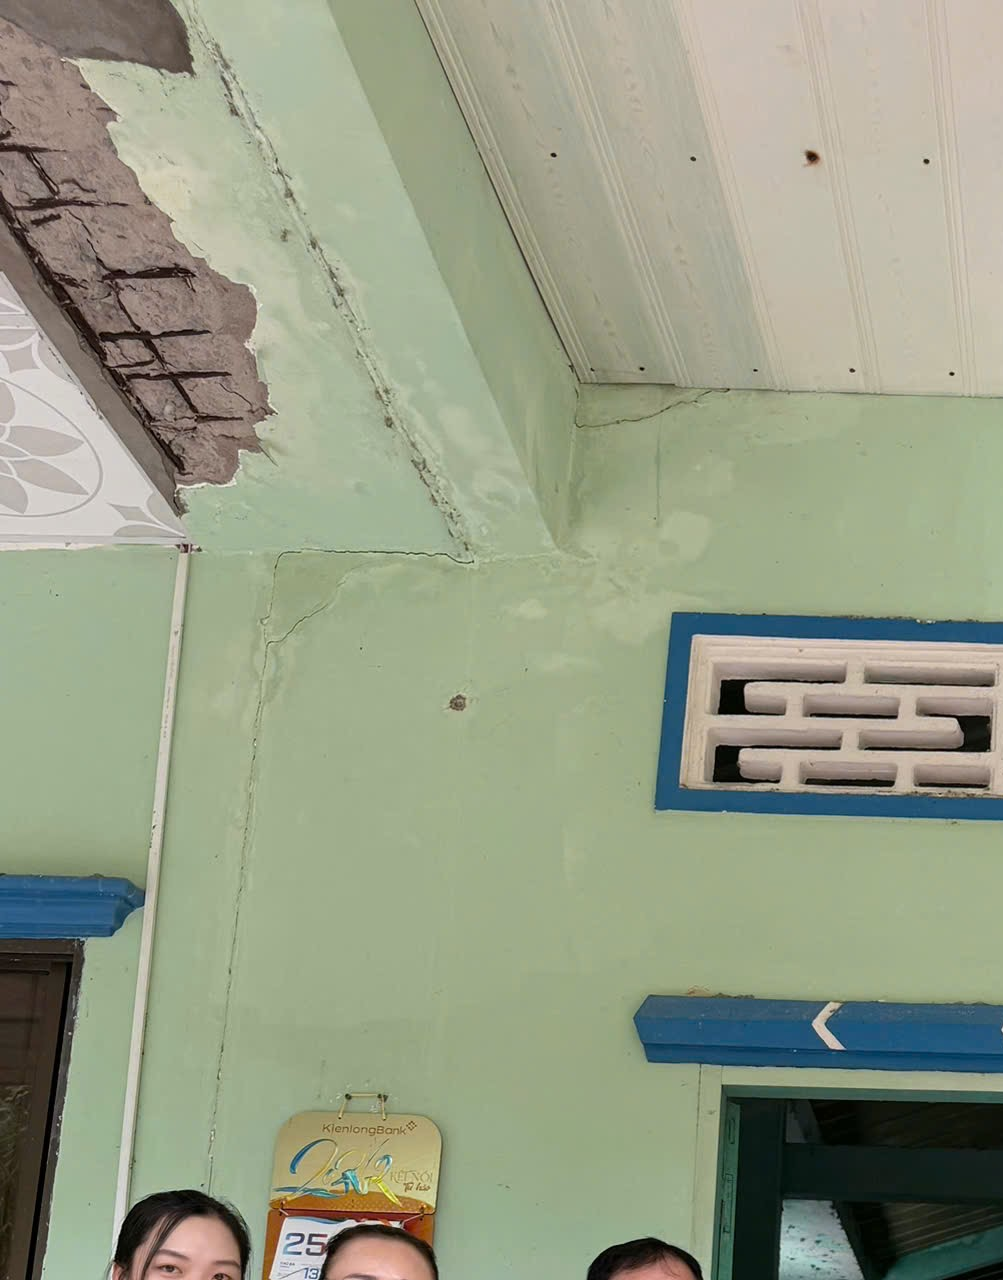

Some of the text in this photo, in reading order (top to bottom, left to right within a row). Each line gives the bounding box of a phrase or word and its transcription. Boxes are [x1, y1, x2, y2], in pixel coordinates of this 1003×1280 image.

[322, 1123, 407, 1137] KienlongBank
[283, 1232, 328, 1256] 25
[303, 1267, 319, 1280] 13
